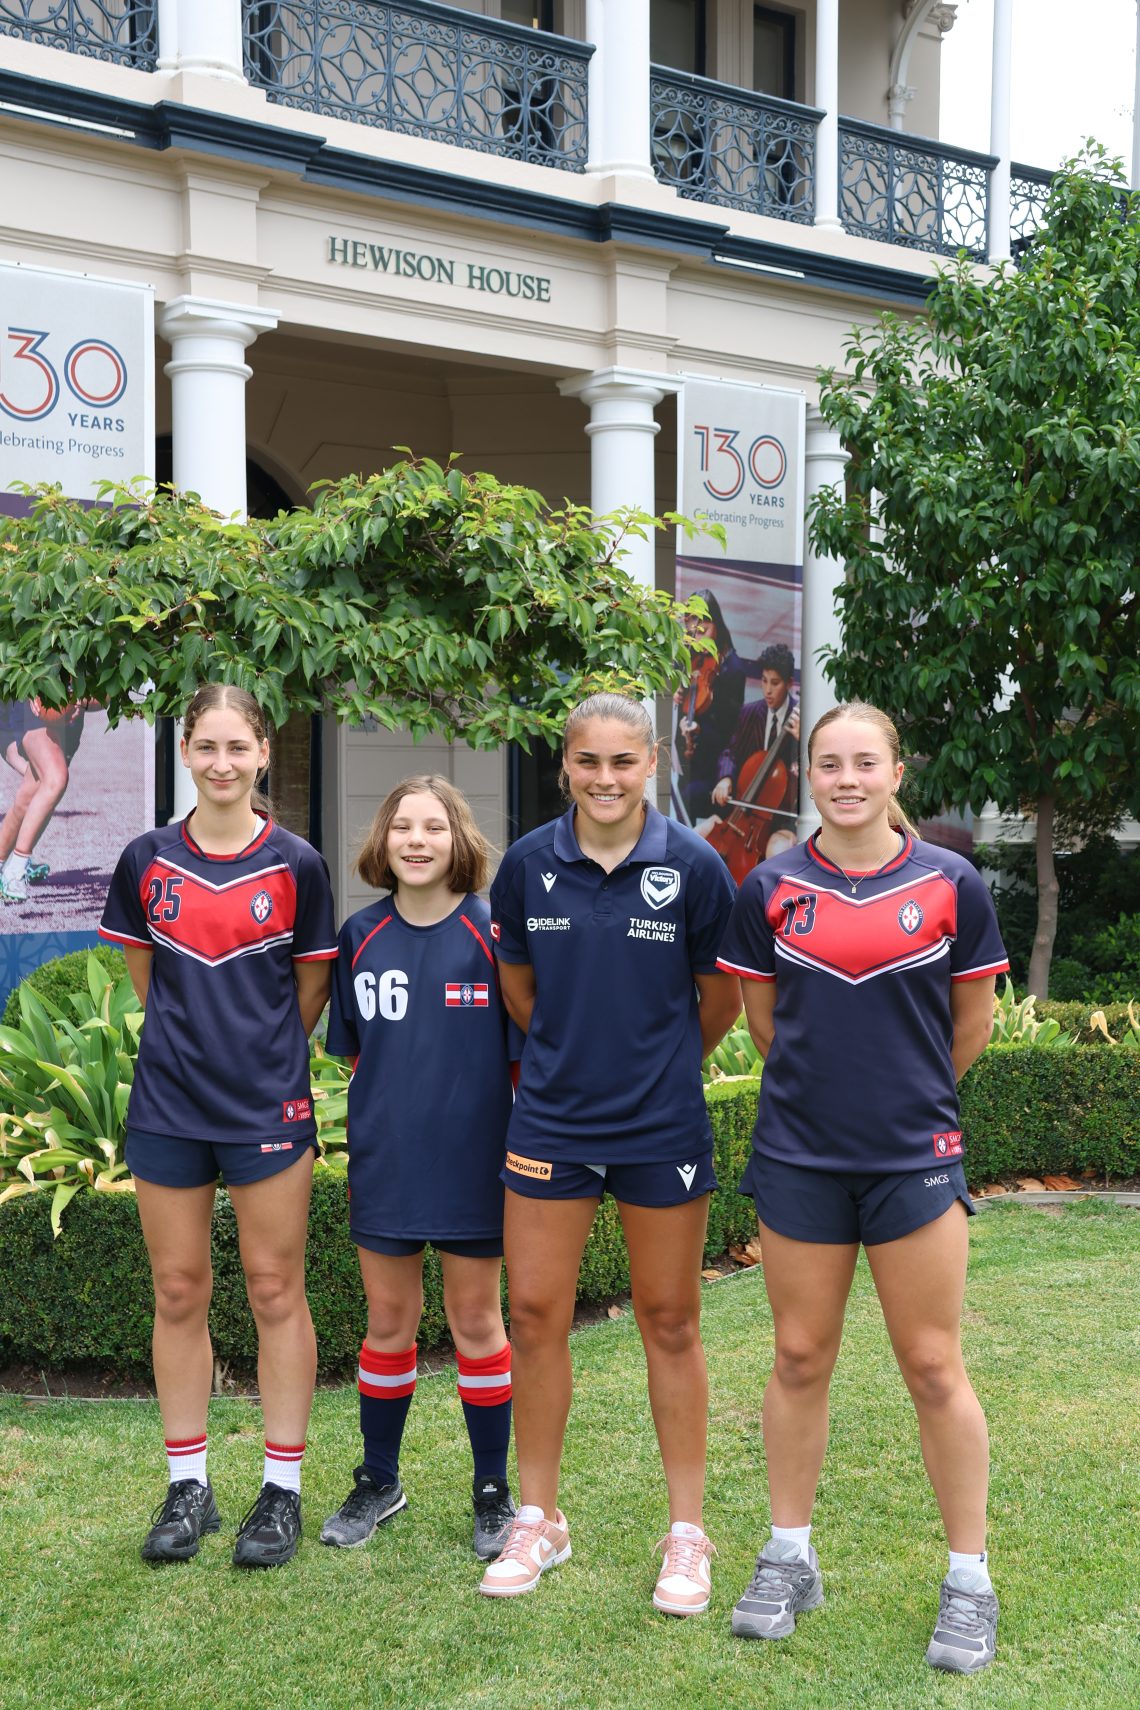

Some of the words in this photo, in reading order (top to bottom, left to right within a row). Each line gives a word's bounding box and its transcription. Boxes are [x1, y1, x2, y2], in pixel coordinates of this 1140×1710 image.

[328, 236, 455, 285] HEWISON
[467, 263, 551, 303] HOUSE
[0, 326, 128, 422] 30
[67, 412, 125, 432] YEARS
[68, 438, 125, 459] Progress
[693, 424, 787, 502] 130
[749, 492, 785, 508] YEARS
[749, 513, 785, 529] Progress
[650, 874, 674, 885] Victory
[147, 877, 184, 923] 25
[629, 917, 676, 932] TURKISH
[780, 893, 818, 936] 13
[626, 928, 675, 942] AIRLINES
[353, 969, 409, 1021] 66
[923, 1174, 949, 1188] SMGS
